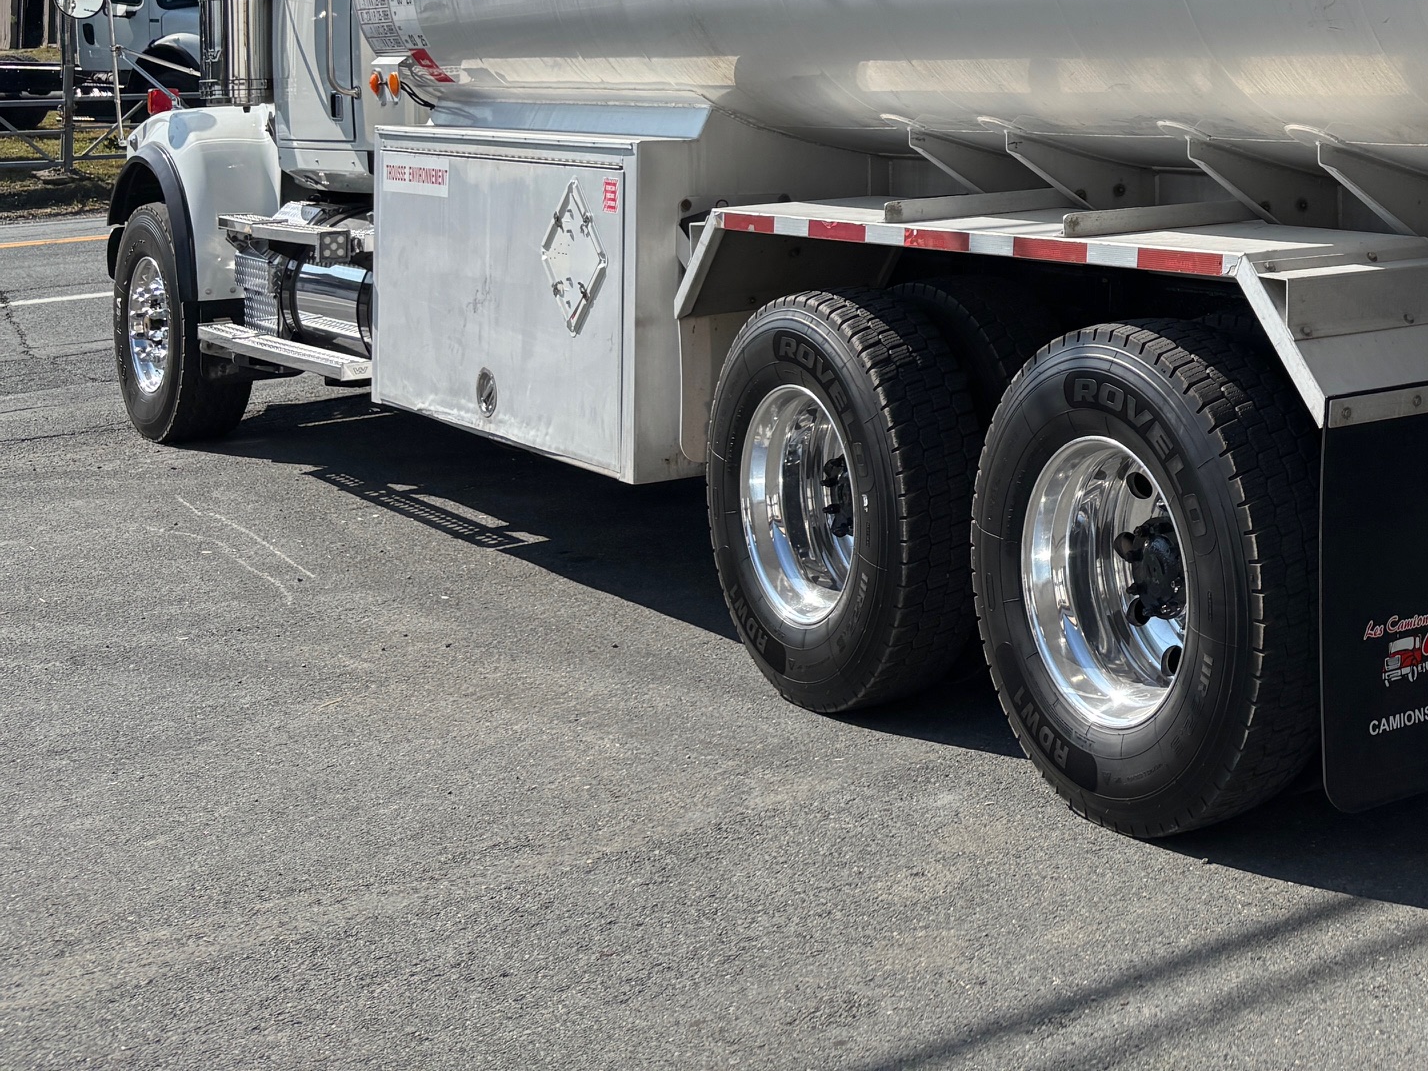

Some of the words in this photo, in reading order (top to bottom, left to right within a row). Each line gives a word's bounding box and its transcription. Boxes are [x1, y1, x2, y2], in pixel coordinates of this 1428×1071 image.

[386, 164, 407, 182] TROUSSE
[1073, 377, 1208, 538] ROVELO
[728, 583, 768, 654] RDW1
[1363, 619, 1384, 641] Les
[1013, 685, 1070, 770] RDW1
